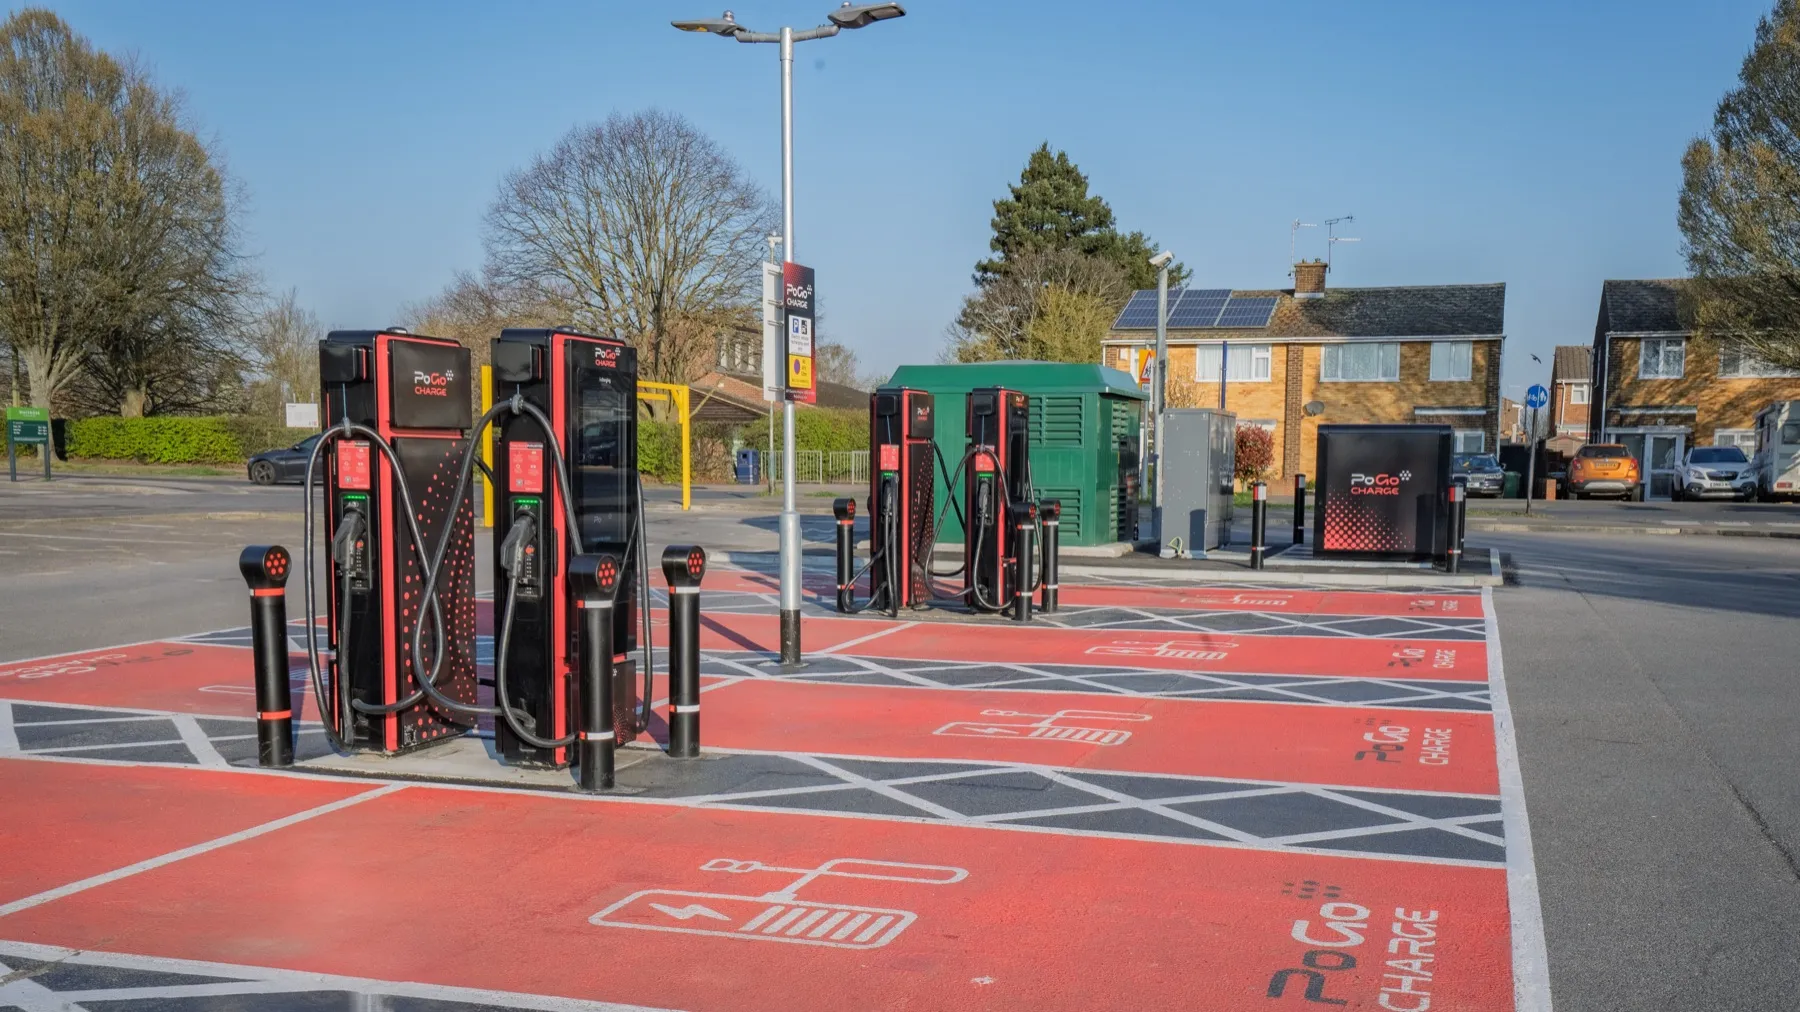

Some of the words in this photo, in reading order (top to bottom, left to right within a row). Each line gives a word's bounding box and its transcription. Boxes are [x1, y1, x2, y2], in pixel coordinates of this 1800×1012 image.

[786, 283, 808, 300] PoGo
[786, 299, 808, 309] CHARGE
[595, 347, 616, 359] PoGo
[595, 359, 616, 368] CHARGE
[414, 370, 447, 386] PoGo
[414, 386, 447, 396] CHARGE
[1351, 473, 1399, 486] PoGo
[1350, 487, 1399, 495] CHARGE
[1419, 727, 1452, 765] CHARGE
[1266, 902, 1371, 1007] PoGo
[1379, 907, 1439, 1012] CHARGE
